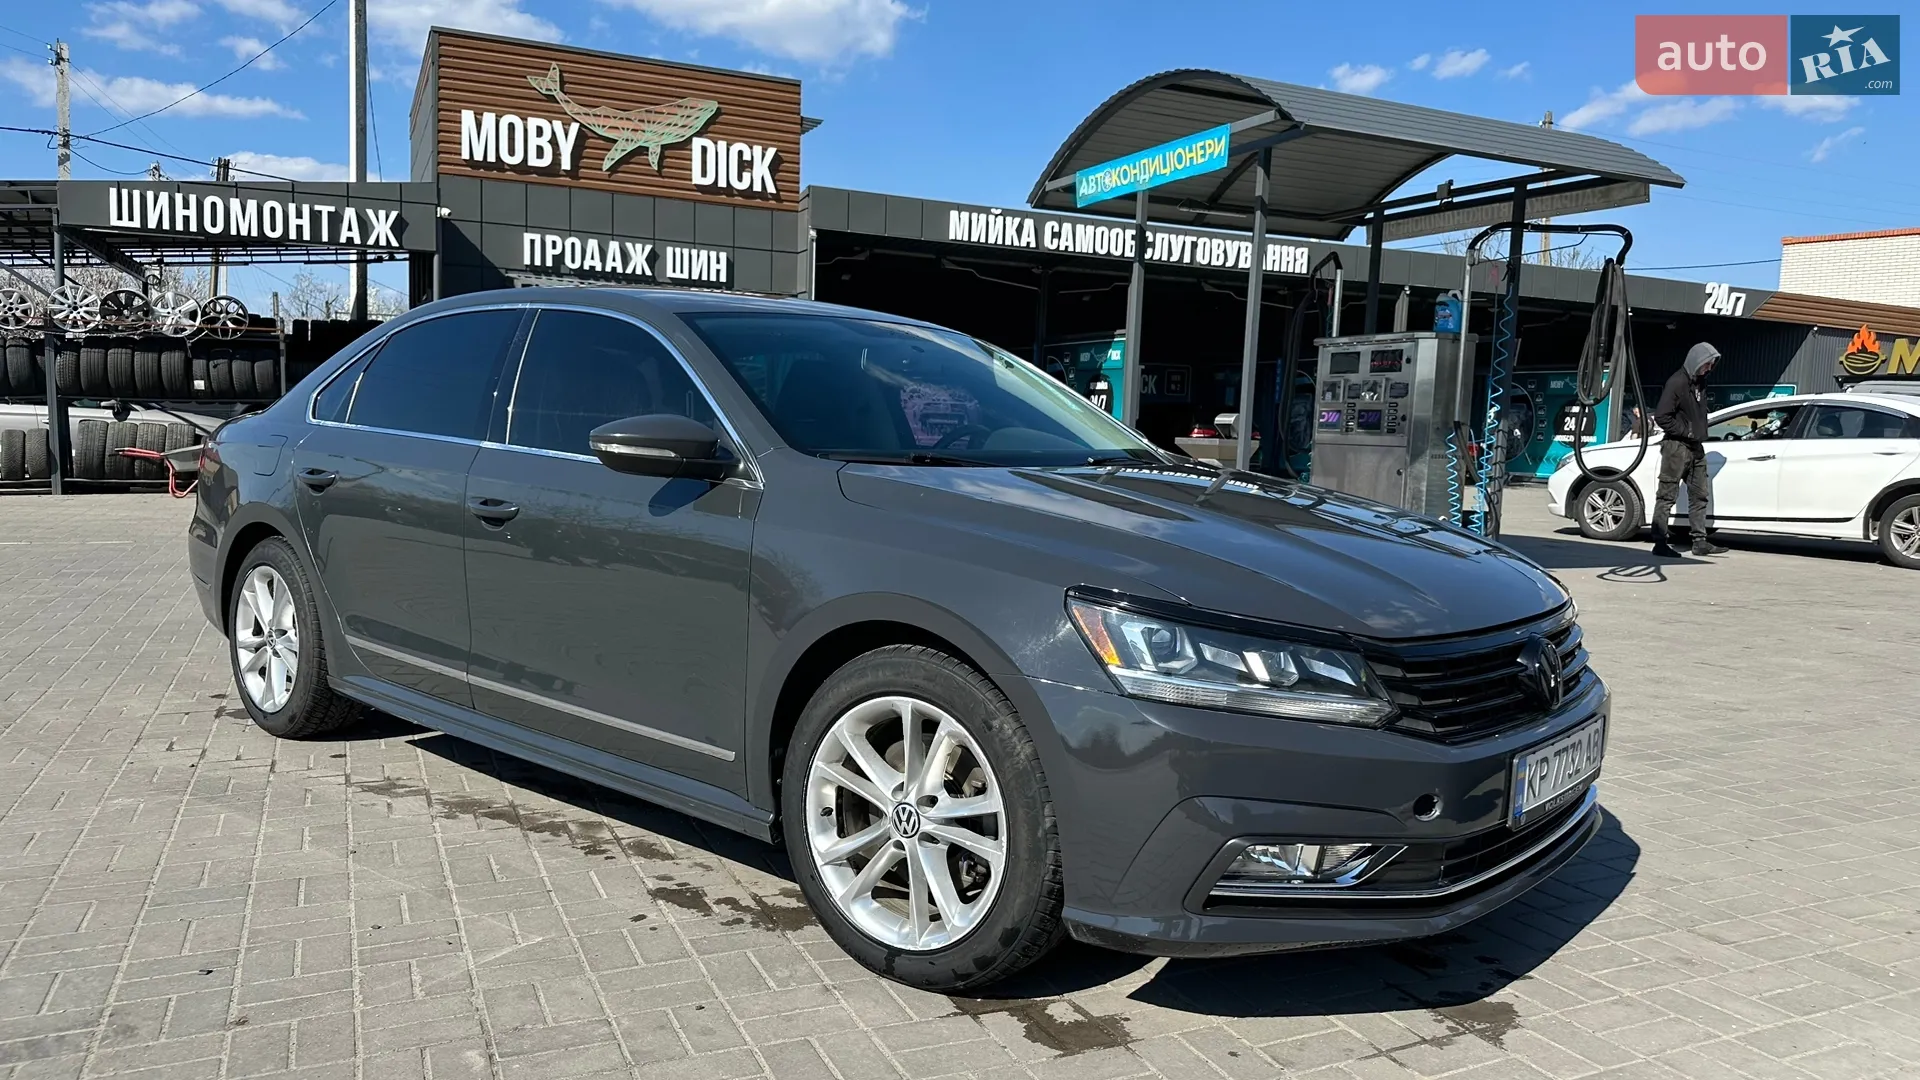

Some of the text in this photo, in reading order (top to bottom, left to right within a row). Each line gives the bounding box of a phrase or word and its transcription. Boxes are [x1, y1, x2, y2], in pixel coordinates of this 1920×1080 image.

[461, 109, 777, 194] MOBY DICK
[109, 187, 400, 247] ШИНОМОНТАЖ
[949, 207, 1037, 249] МИЙКА
[523, 232, 728, 283] ПРОДАЖ ШИН
[1703, 281, 1747, 317] 24/7
[1523, 728, 1600, 803] KP 7732 AB
